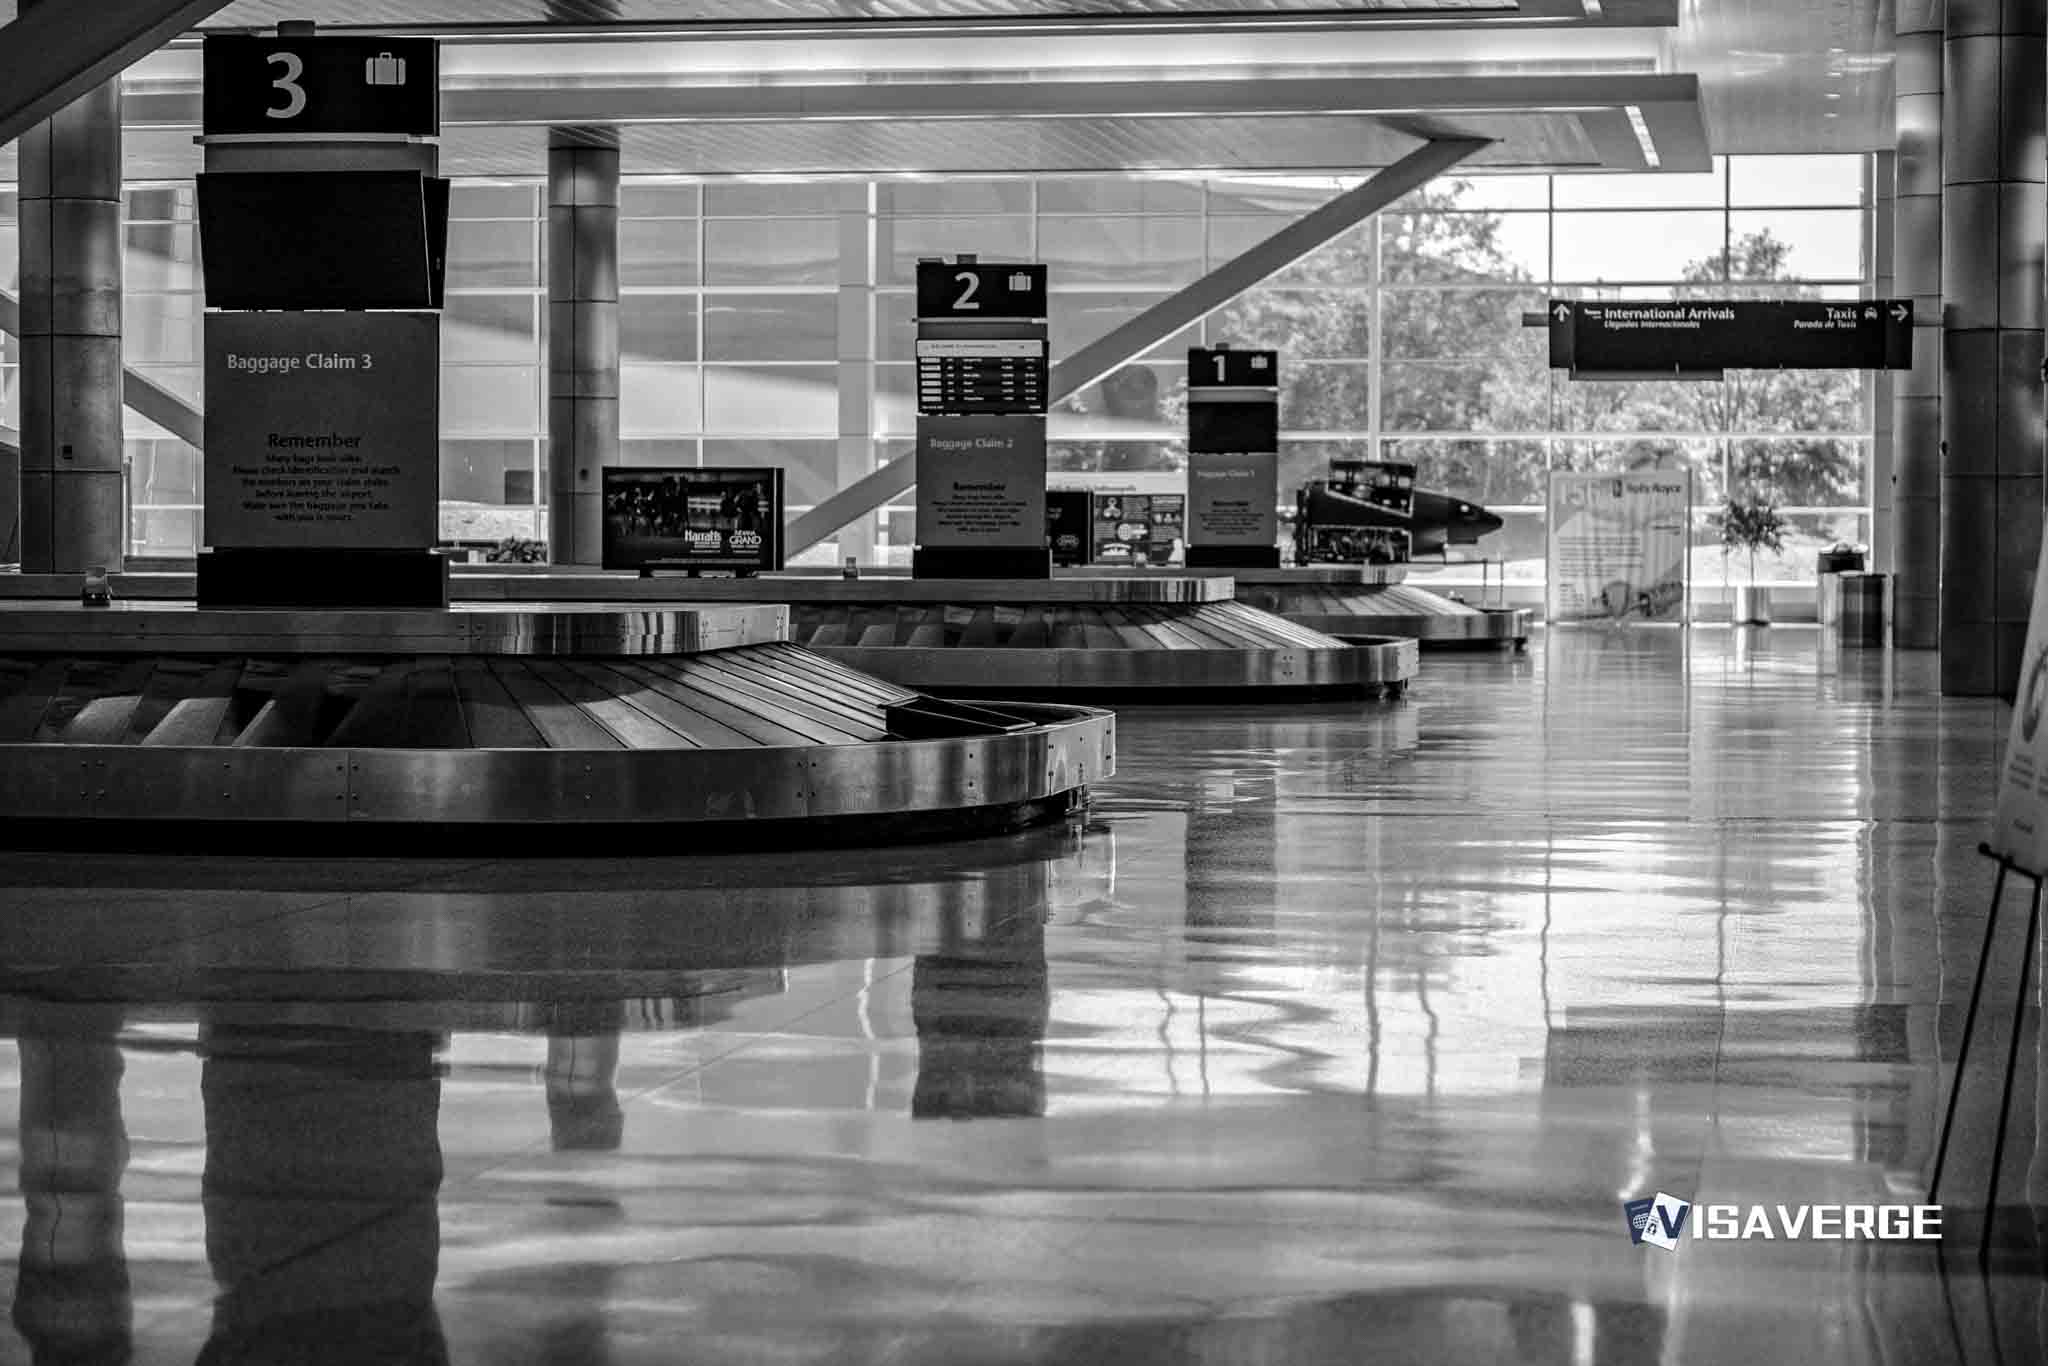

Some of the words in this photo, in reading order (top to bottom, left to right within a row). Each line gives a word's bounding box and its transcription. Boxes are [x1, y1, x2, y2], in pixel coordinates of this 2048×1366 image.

[265, 51, 307, 118] 3
[953, 271, 980, 309] 2
[1604, 307, 1686, 320] International
[1688, 307, 1735, 320] Arrivals
[1825, 307, 1857, 320] Taxis
[226, 354, 301, 374] Baggage
[305, 353, 356, 370] Claim
[361, 353, 373, 370] 3
[1211, 355, 1225, 382] 1
[268, 433, 361, 449] Remember
[929, 438, 973, 450] Baggage
[975, 438, 1005, 449] Claim
[1006, 438, 1014, 449] 2
[729, 535, 762, 545] GRAND
